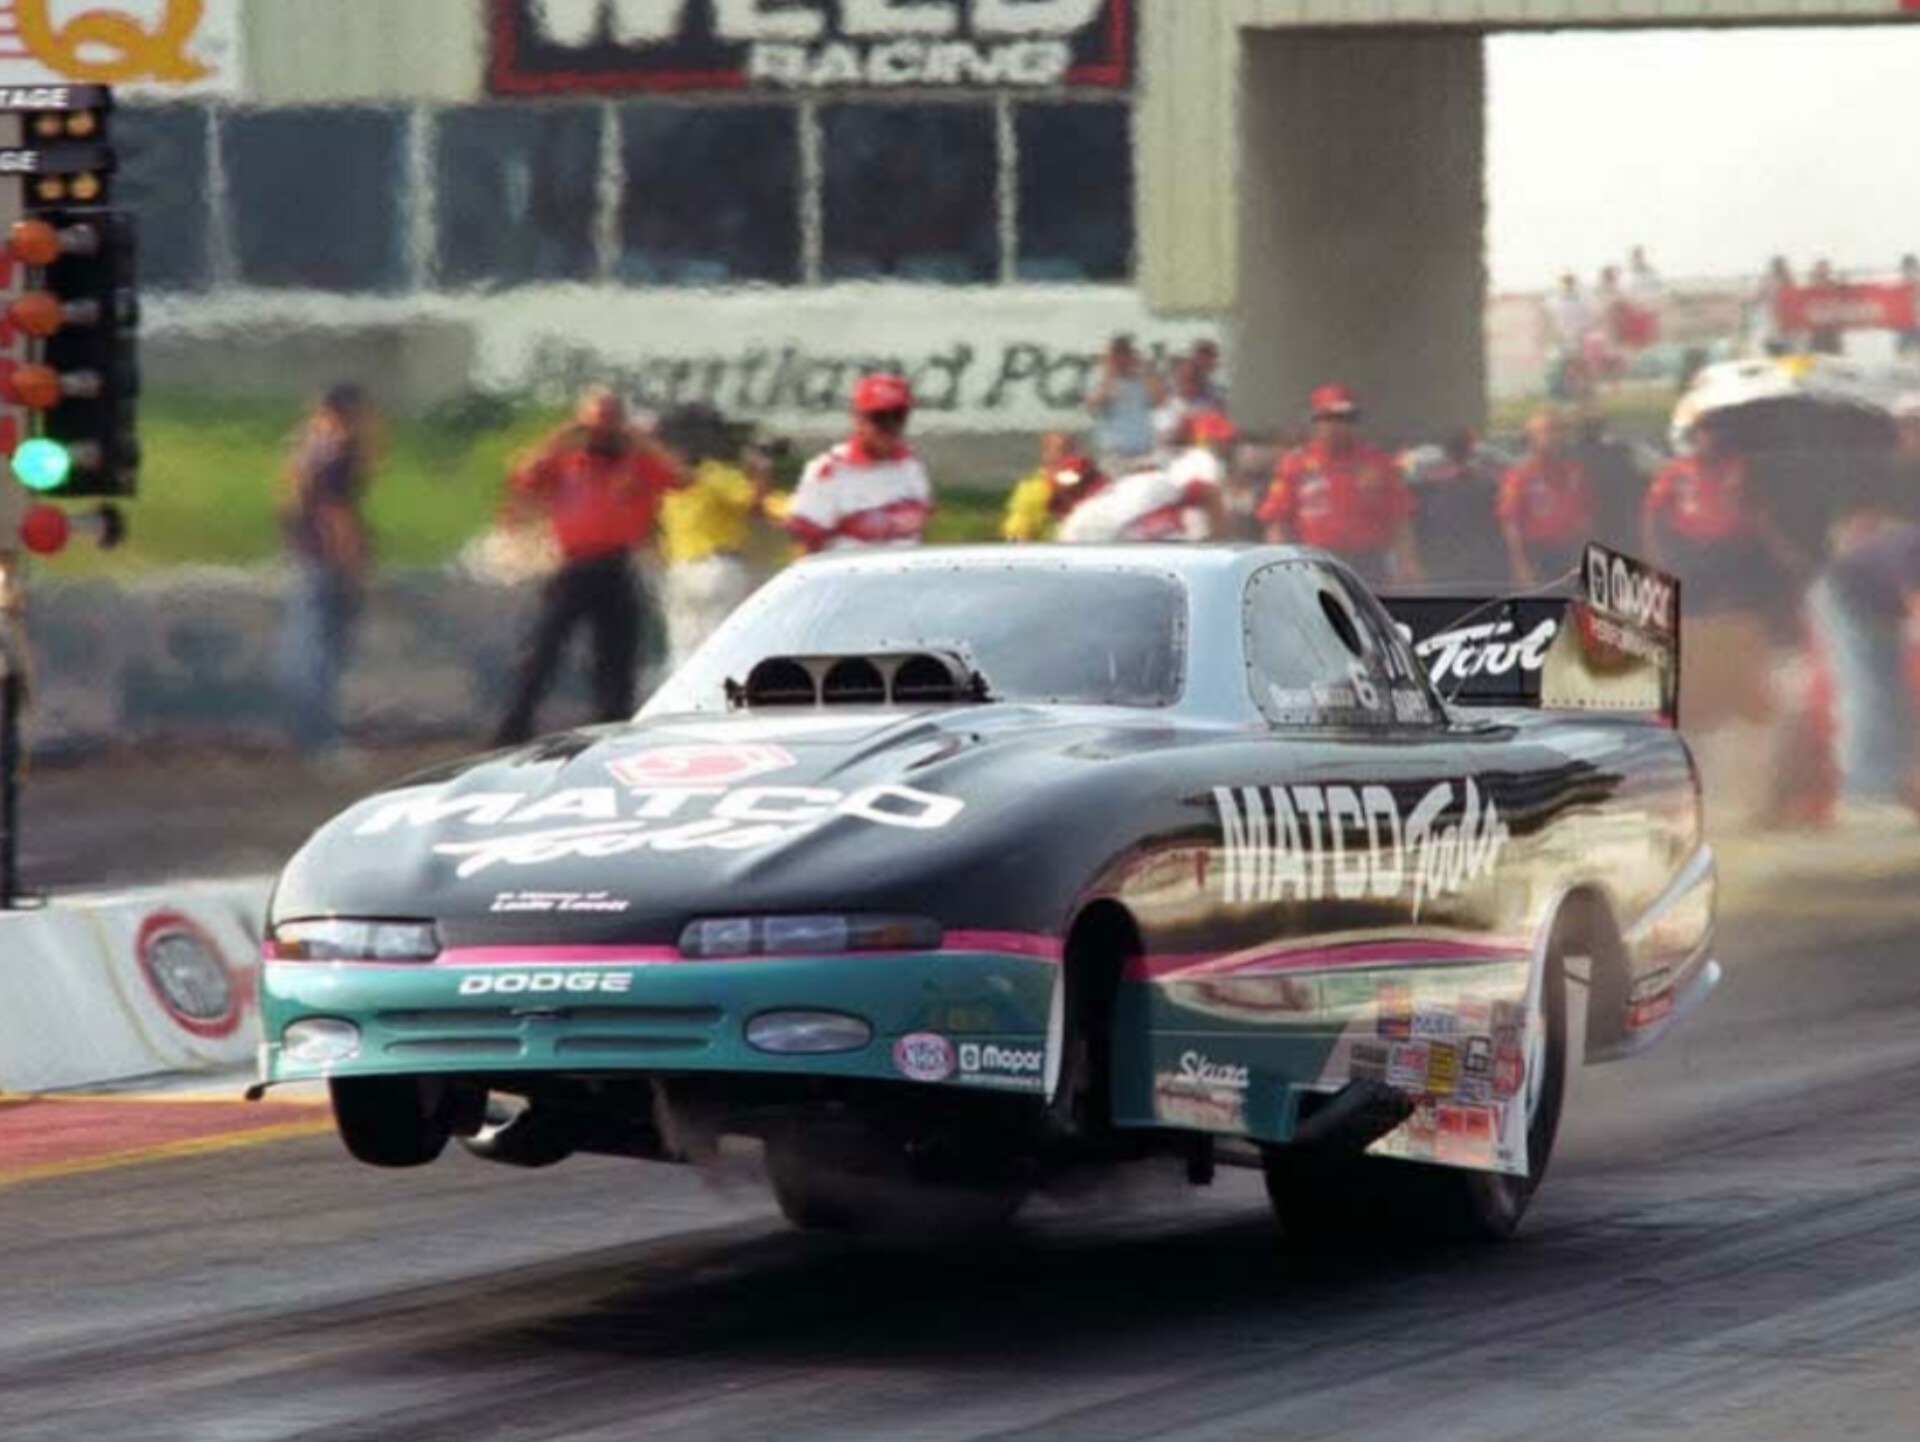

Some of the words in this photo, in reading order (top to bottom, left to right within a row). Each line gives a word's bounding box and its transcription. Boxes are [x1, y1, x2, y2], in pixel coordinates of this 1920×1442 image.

[748, 41, 1070, 85] RACING
[1414, 619, 1557, 684] Tool
[356, 784, 966, 834] MATCO
[1213, 786, 1404, 903] MATCO
[459, 972, 633, 995] DODGE
